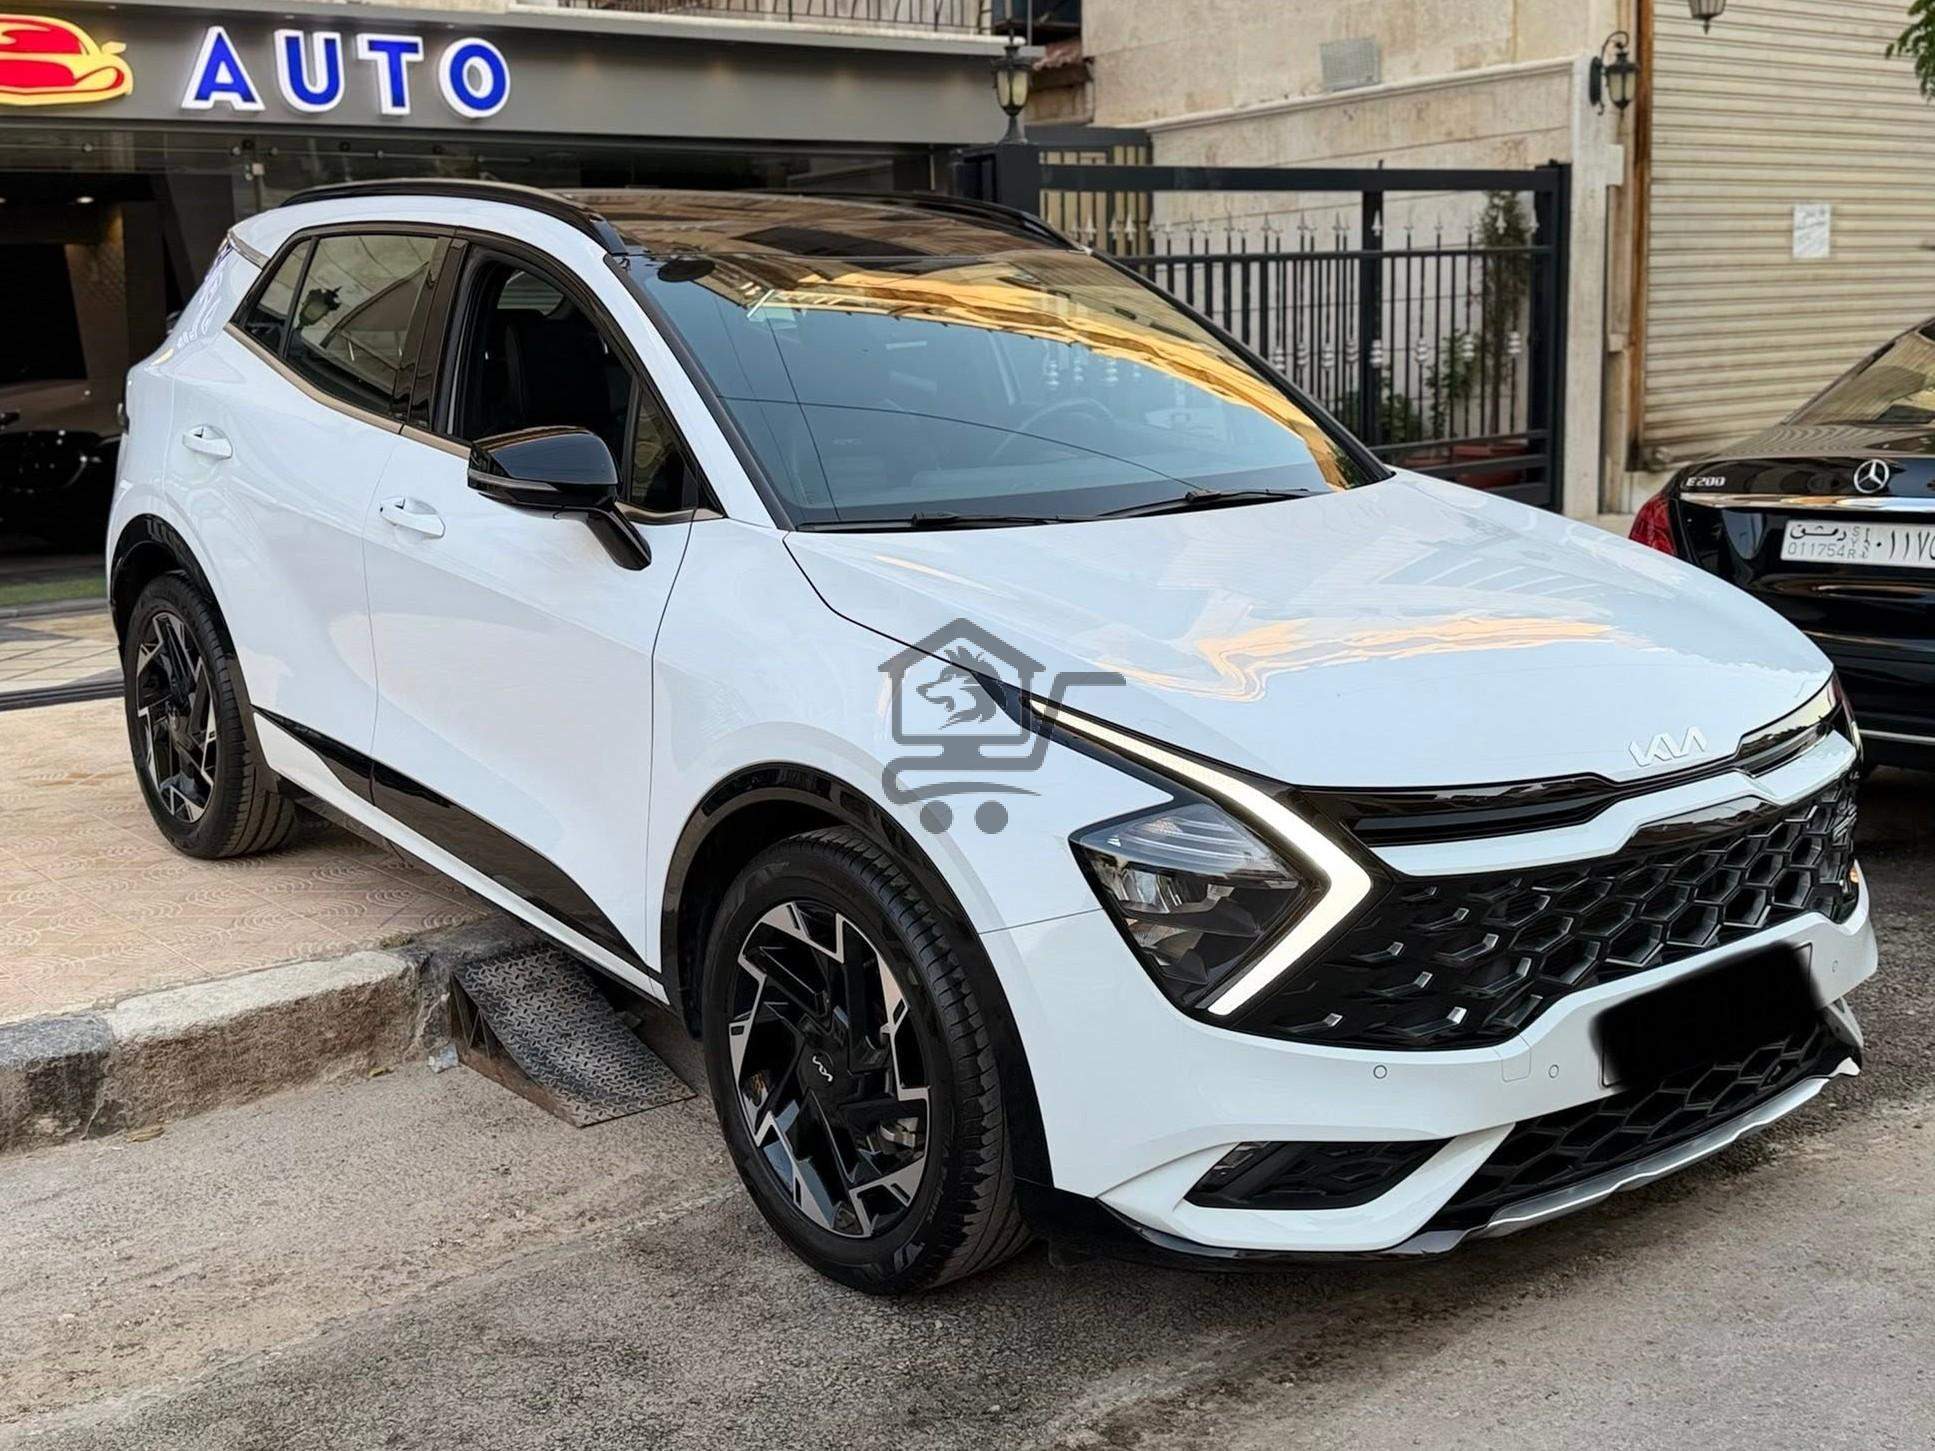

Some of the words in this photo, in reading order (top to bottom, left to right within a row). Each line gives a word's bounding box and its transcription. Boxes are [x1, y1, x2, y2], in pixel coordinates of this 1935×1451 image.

[181, 26, 511, 118] AUTO
[1788, 541, 1845, 557] 011754
[1628, 726, 1707, 768] KIA
